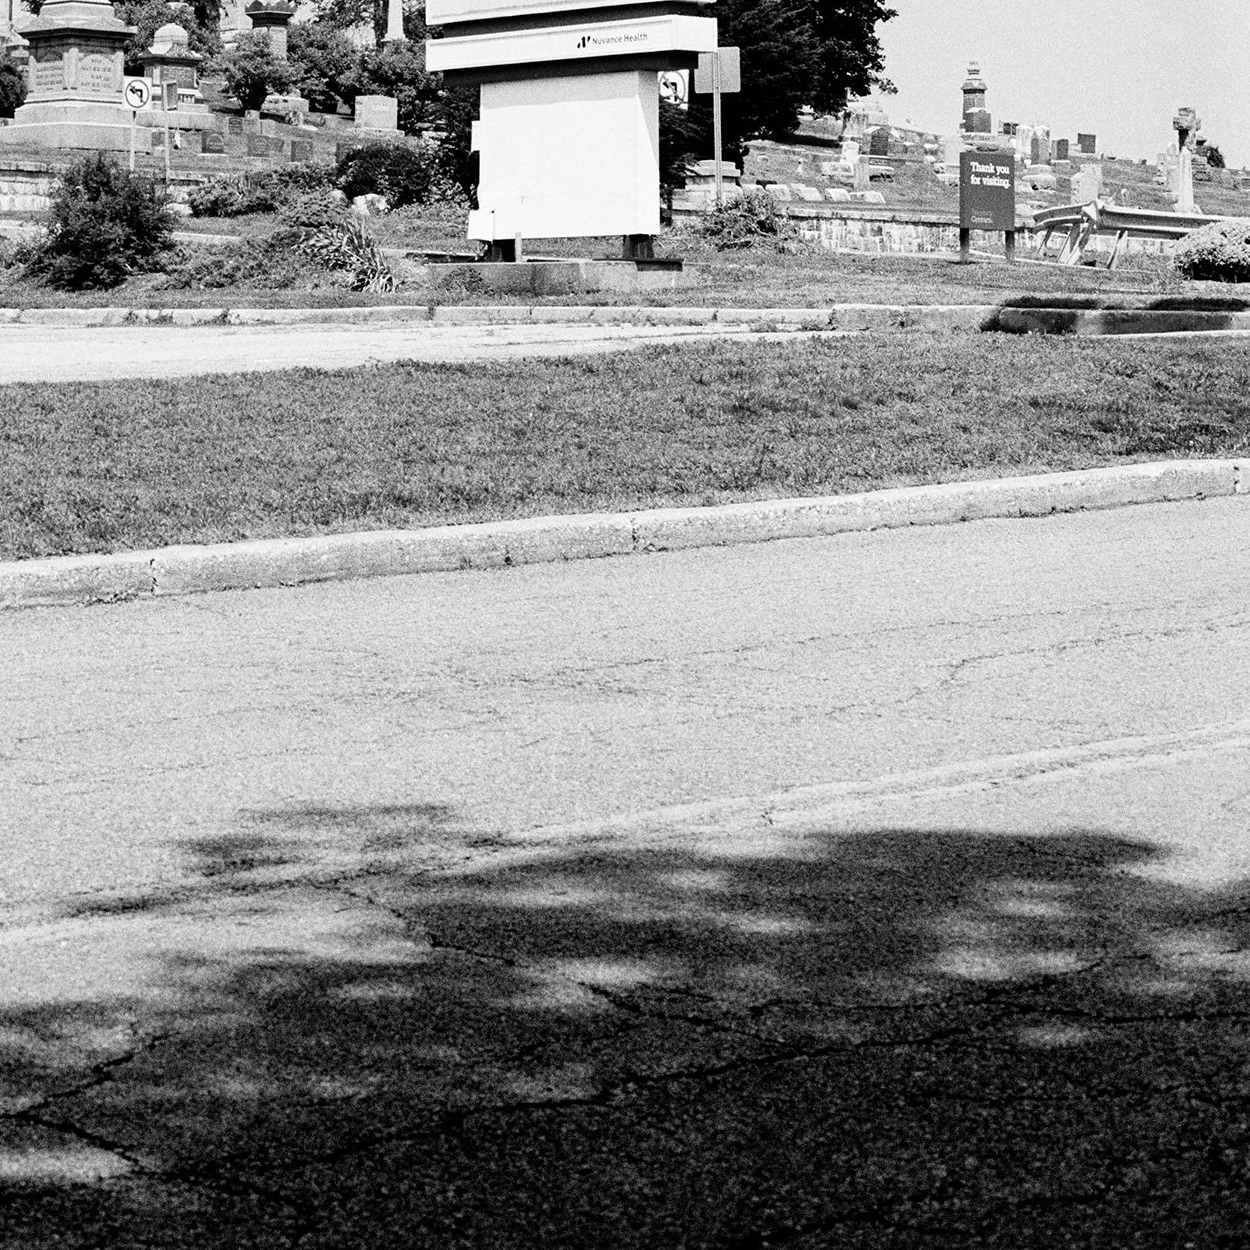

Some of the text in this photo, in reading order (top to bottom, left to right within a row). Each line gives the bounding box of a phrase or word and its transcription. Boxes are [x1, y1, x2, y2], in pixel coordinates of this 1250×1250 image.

[592, 33, 648, 45] Nuvance Health
[970, 162, 1010, 175] Thank you
[970, 174, 1011, 189] for visiting.
